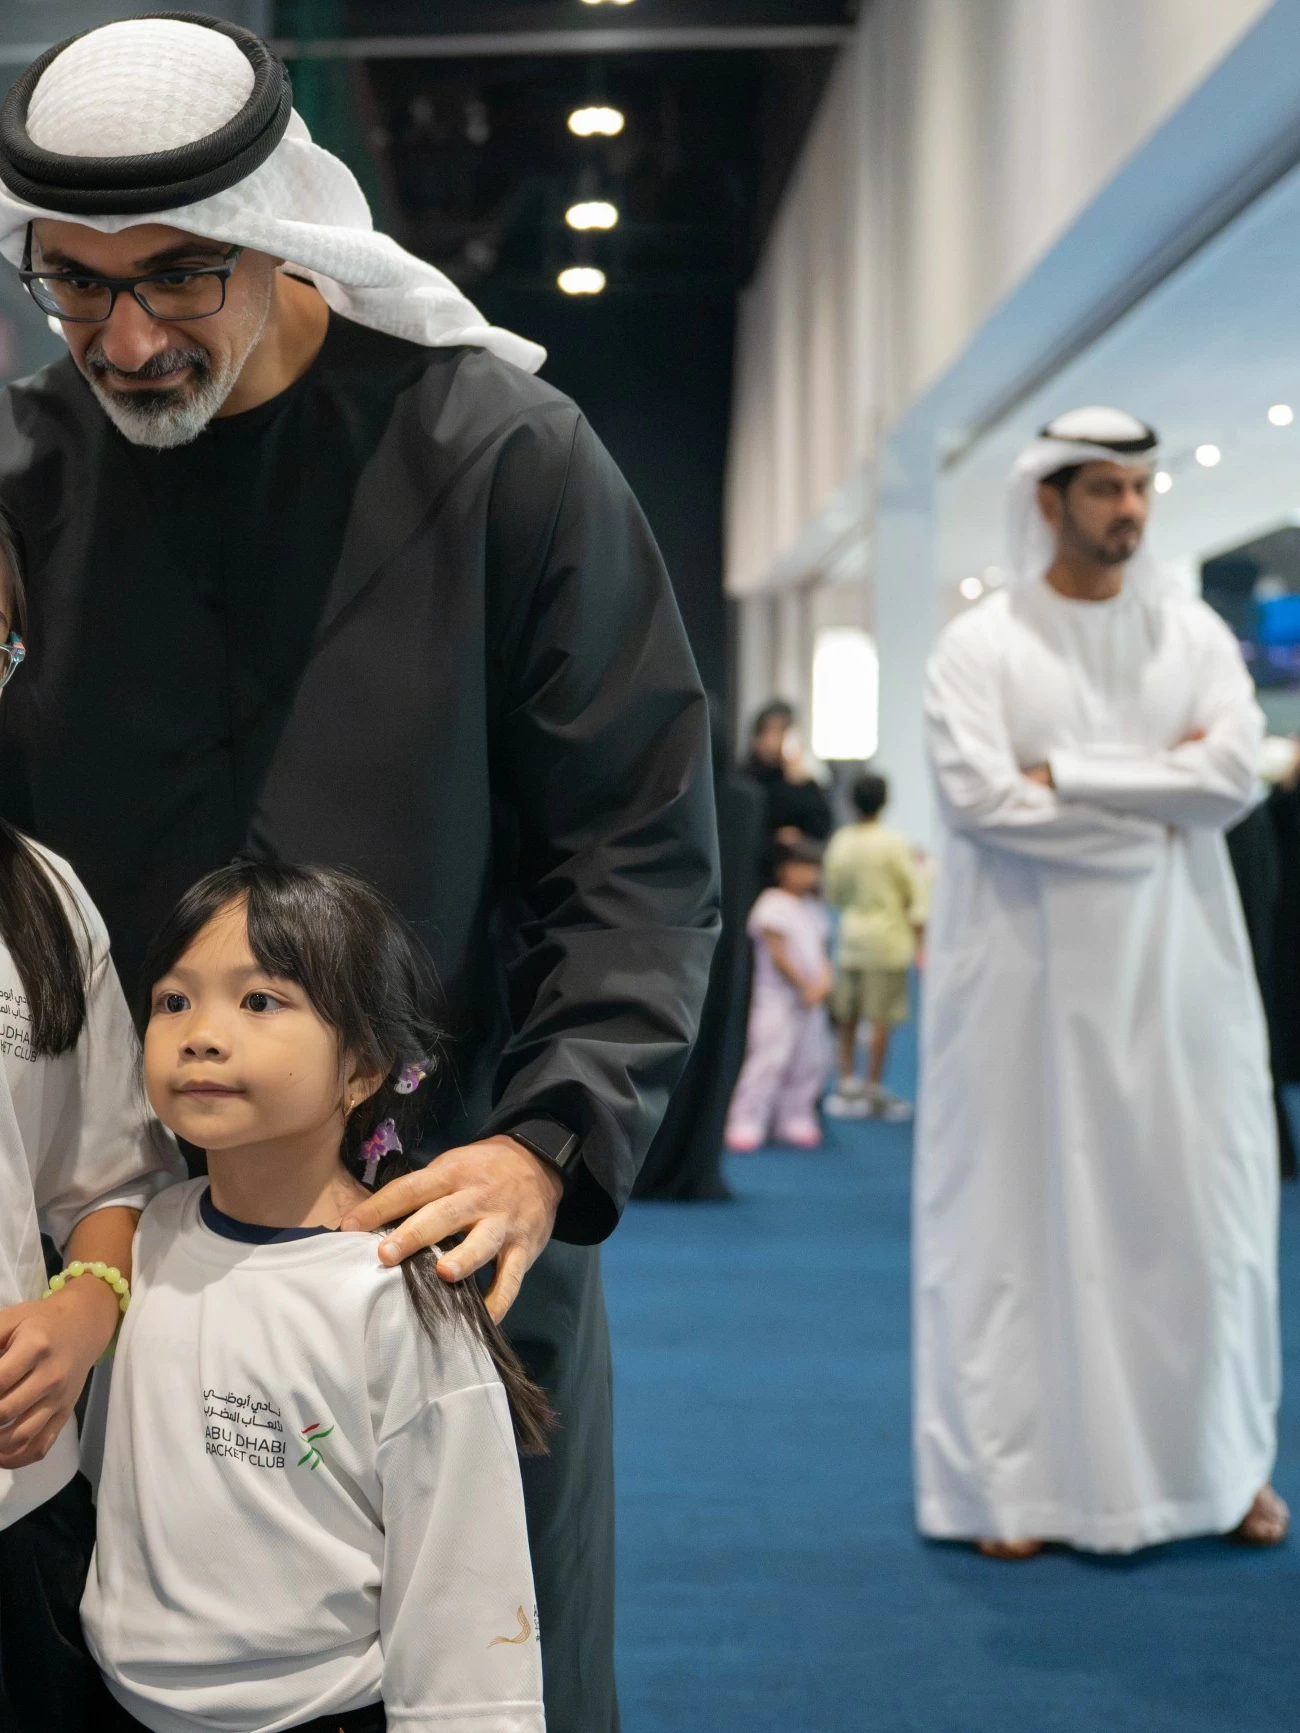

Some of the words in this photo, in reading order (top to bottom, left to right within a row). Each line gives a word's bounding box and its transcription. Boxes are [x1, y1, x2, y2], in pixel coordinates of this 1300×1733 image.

[14, 1045, 38, 1063] CLUB
[203, 1389, 251, 1409] أبوظبي
[205, 1425, 232, 1442] ABU
[236, 1433, 286, 1454] DHABI
[205, 1442, 247, 1462] RACKET
[248, 1454, 285, 1468] CLUB
